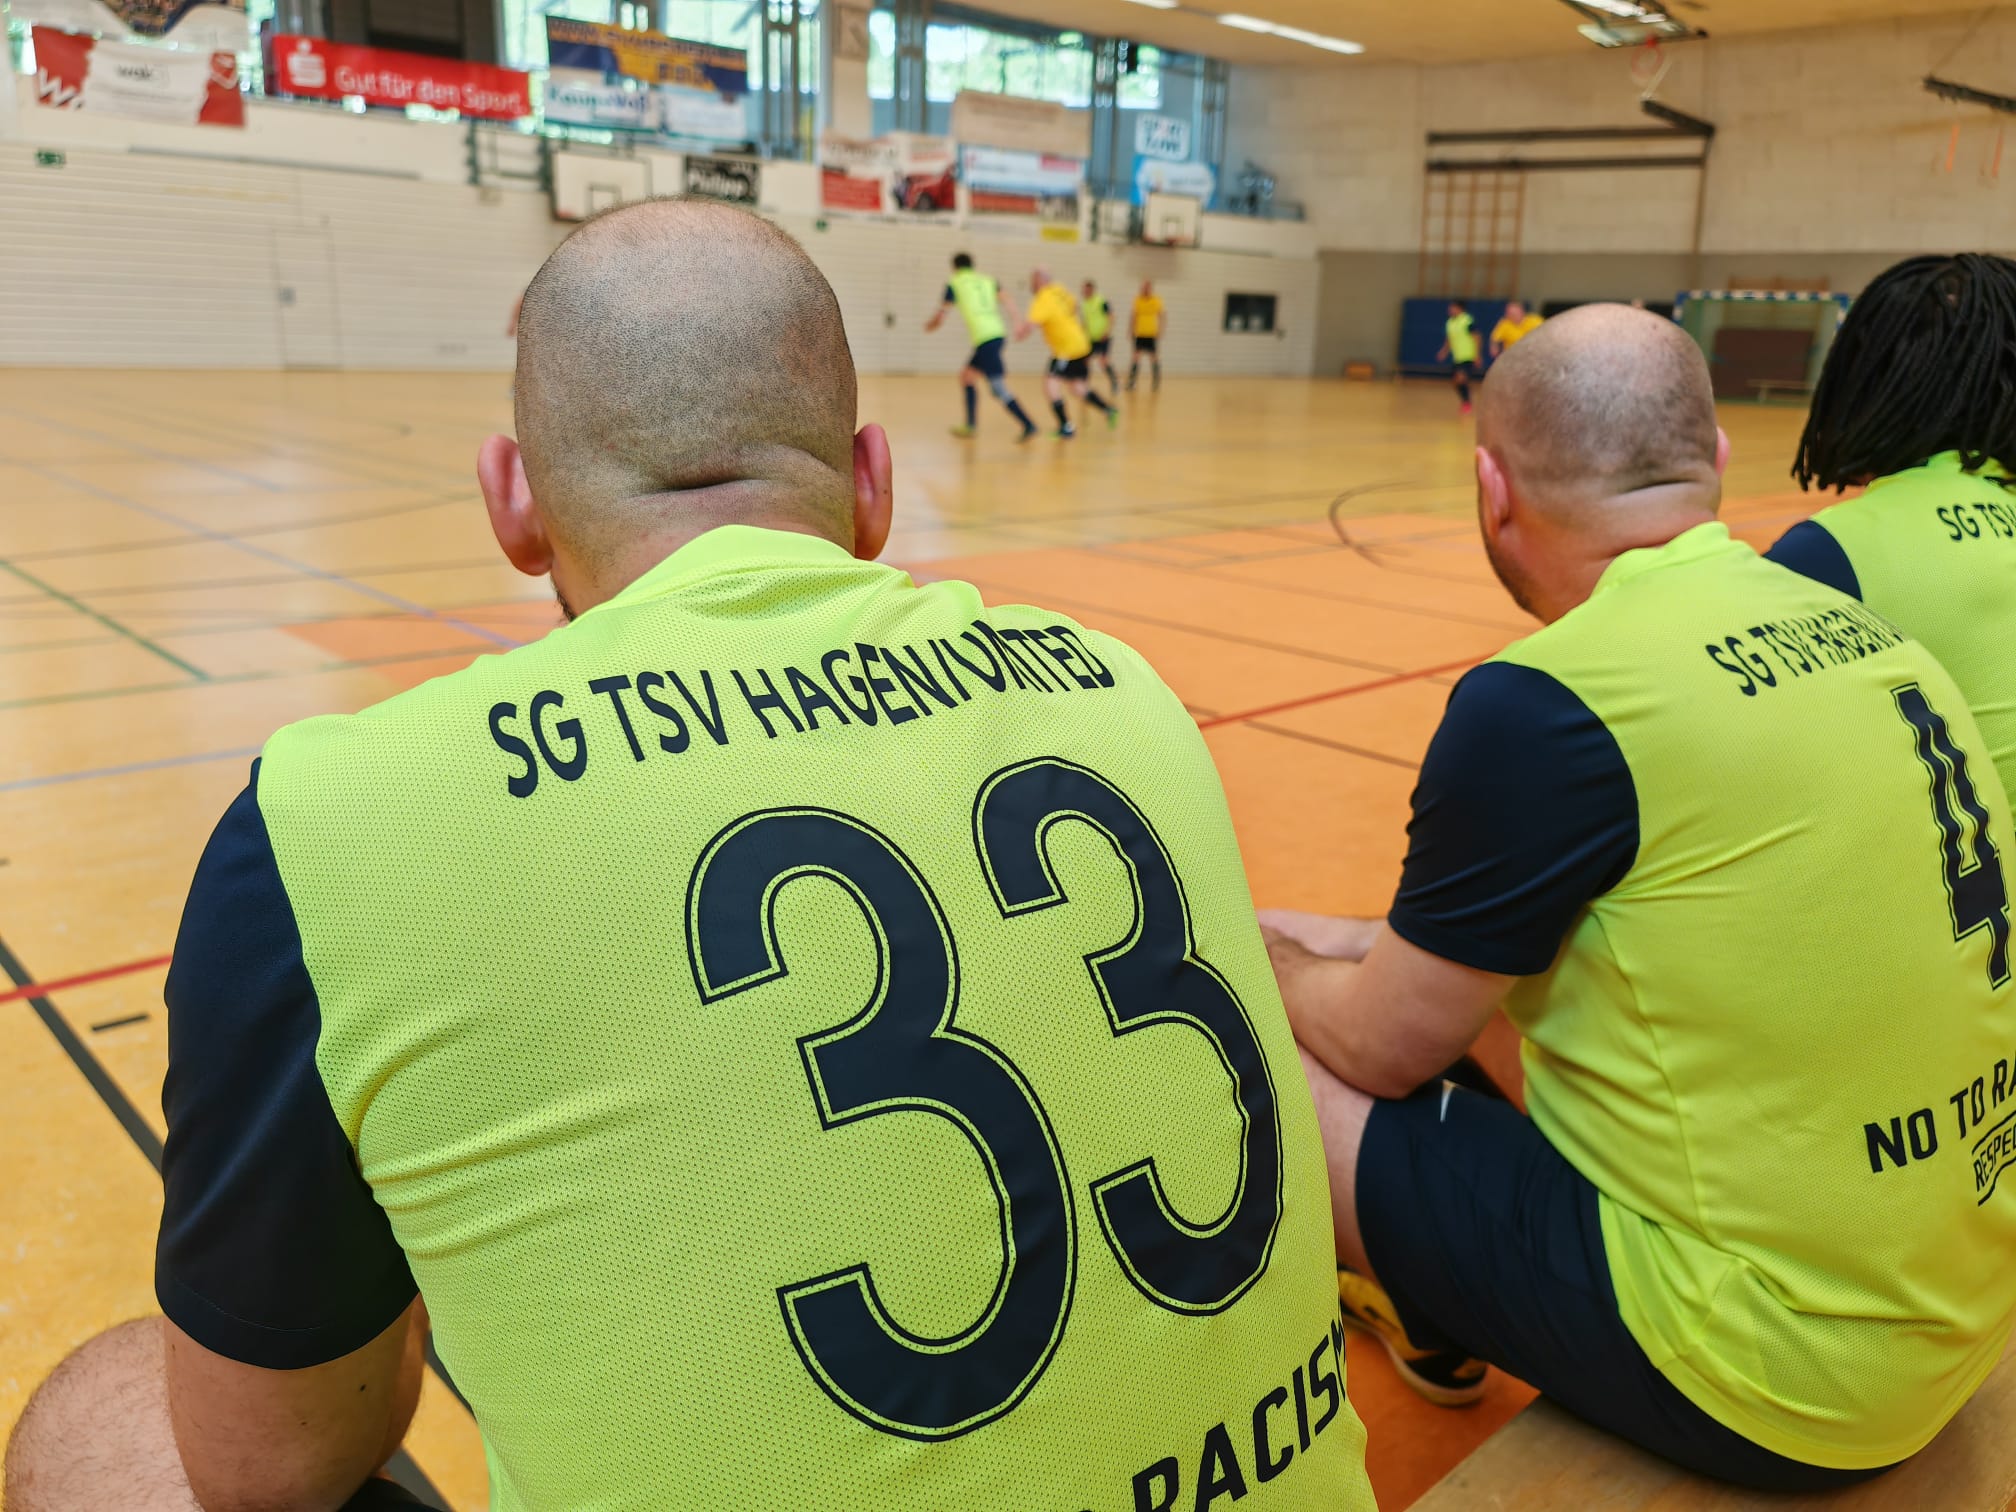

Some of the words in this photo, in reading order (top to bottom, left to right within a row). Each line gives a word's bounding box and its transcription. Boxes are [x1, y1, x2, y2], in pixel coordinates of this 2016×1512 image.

[334, 65, 377, 96] Gut
[416, 76, 460, 105] den
[1937, 503, 1980, 541] SG
[1705, 636, 1777, 697] SG
[488, 690, 588, 798] SG
[588, 671, 729, 762] TSV
[1890, 682, 2011, 992] 4
[685, 756, 1283, 1442] 33
[1863, 1108, 1938, 1173] NO
[1950, 1076, 1985, 1140] TO
